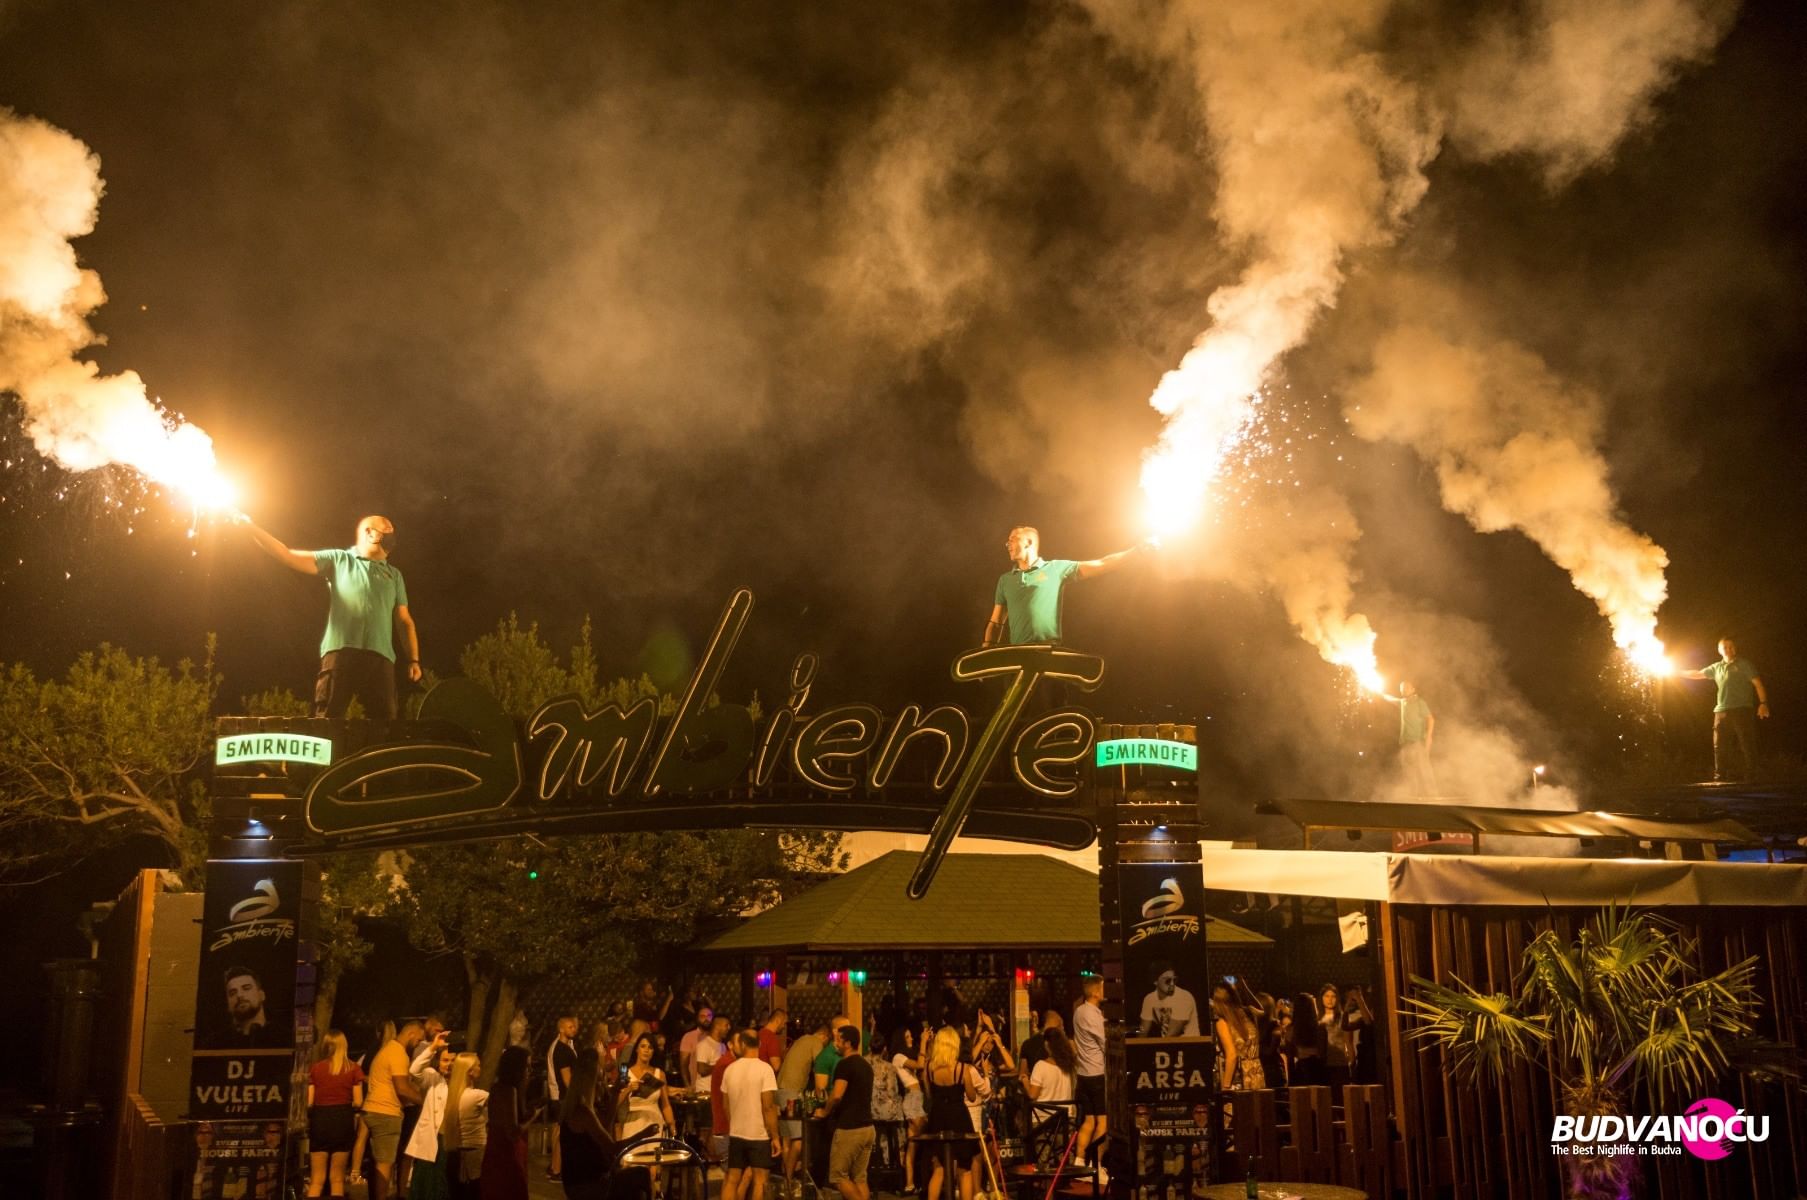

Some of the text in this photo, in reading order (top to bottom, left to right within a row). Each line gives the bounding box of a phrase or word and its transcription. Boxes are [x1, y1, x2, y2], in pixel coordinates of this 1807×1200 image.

[226, 739, 321, 758] SMIRNOFF
[1105, 743, 1189, 763] SMIRNOFF
[1155, 1051, 1184, 1069] DJ
[227, 1061, 256, 1079] DJ
[1136, 1070, 1206, 1089] ARSA
[196, 1085, 282, 1104] VULETA
[225, 1105, 249, 1113] LIVE
[1176, 1128, 1208, 1136] PARTY
[242, 1149, 279, 1157] PARTY
